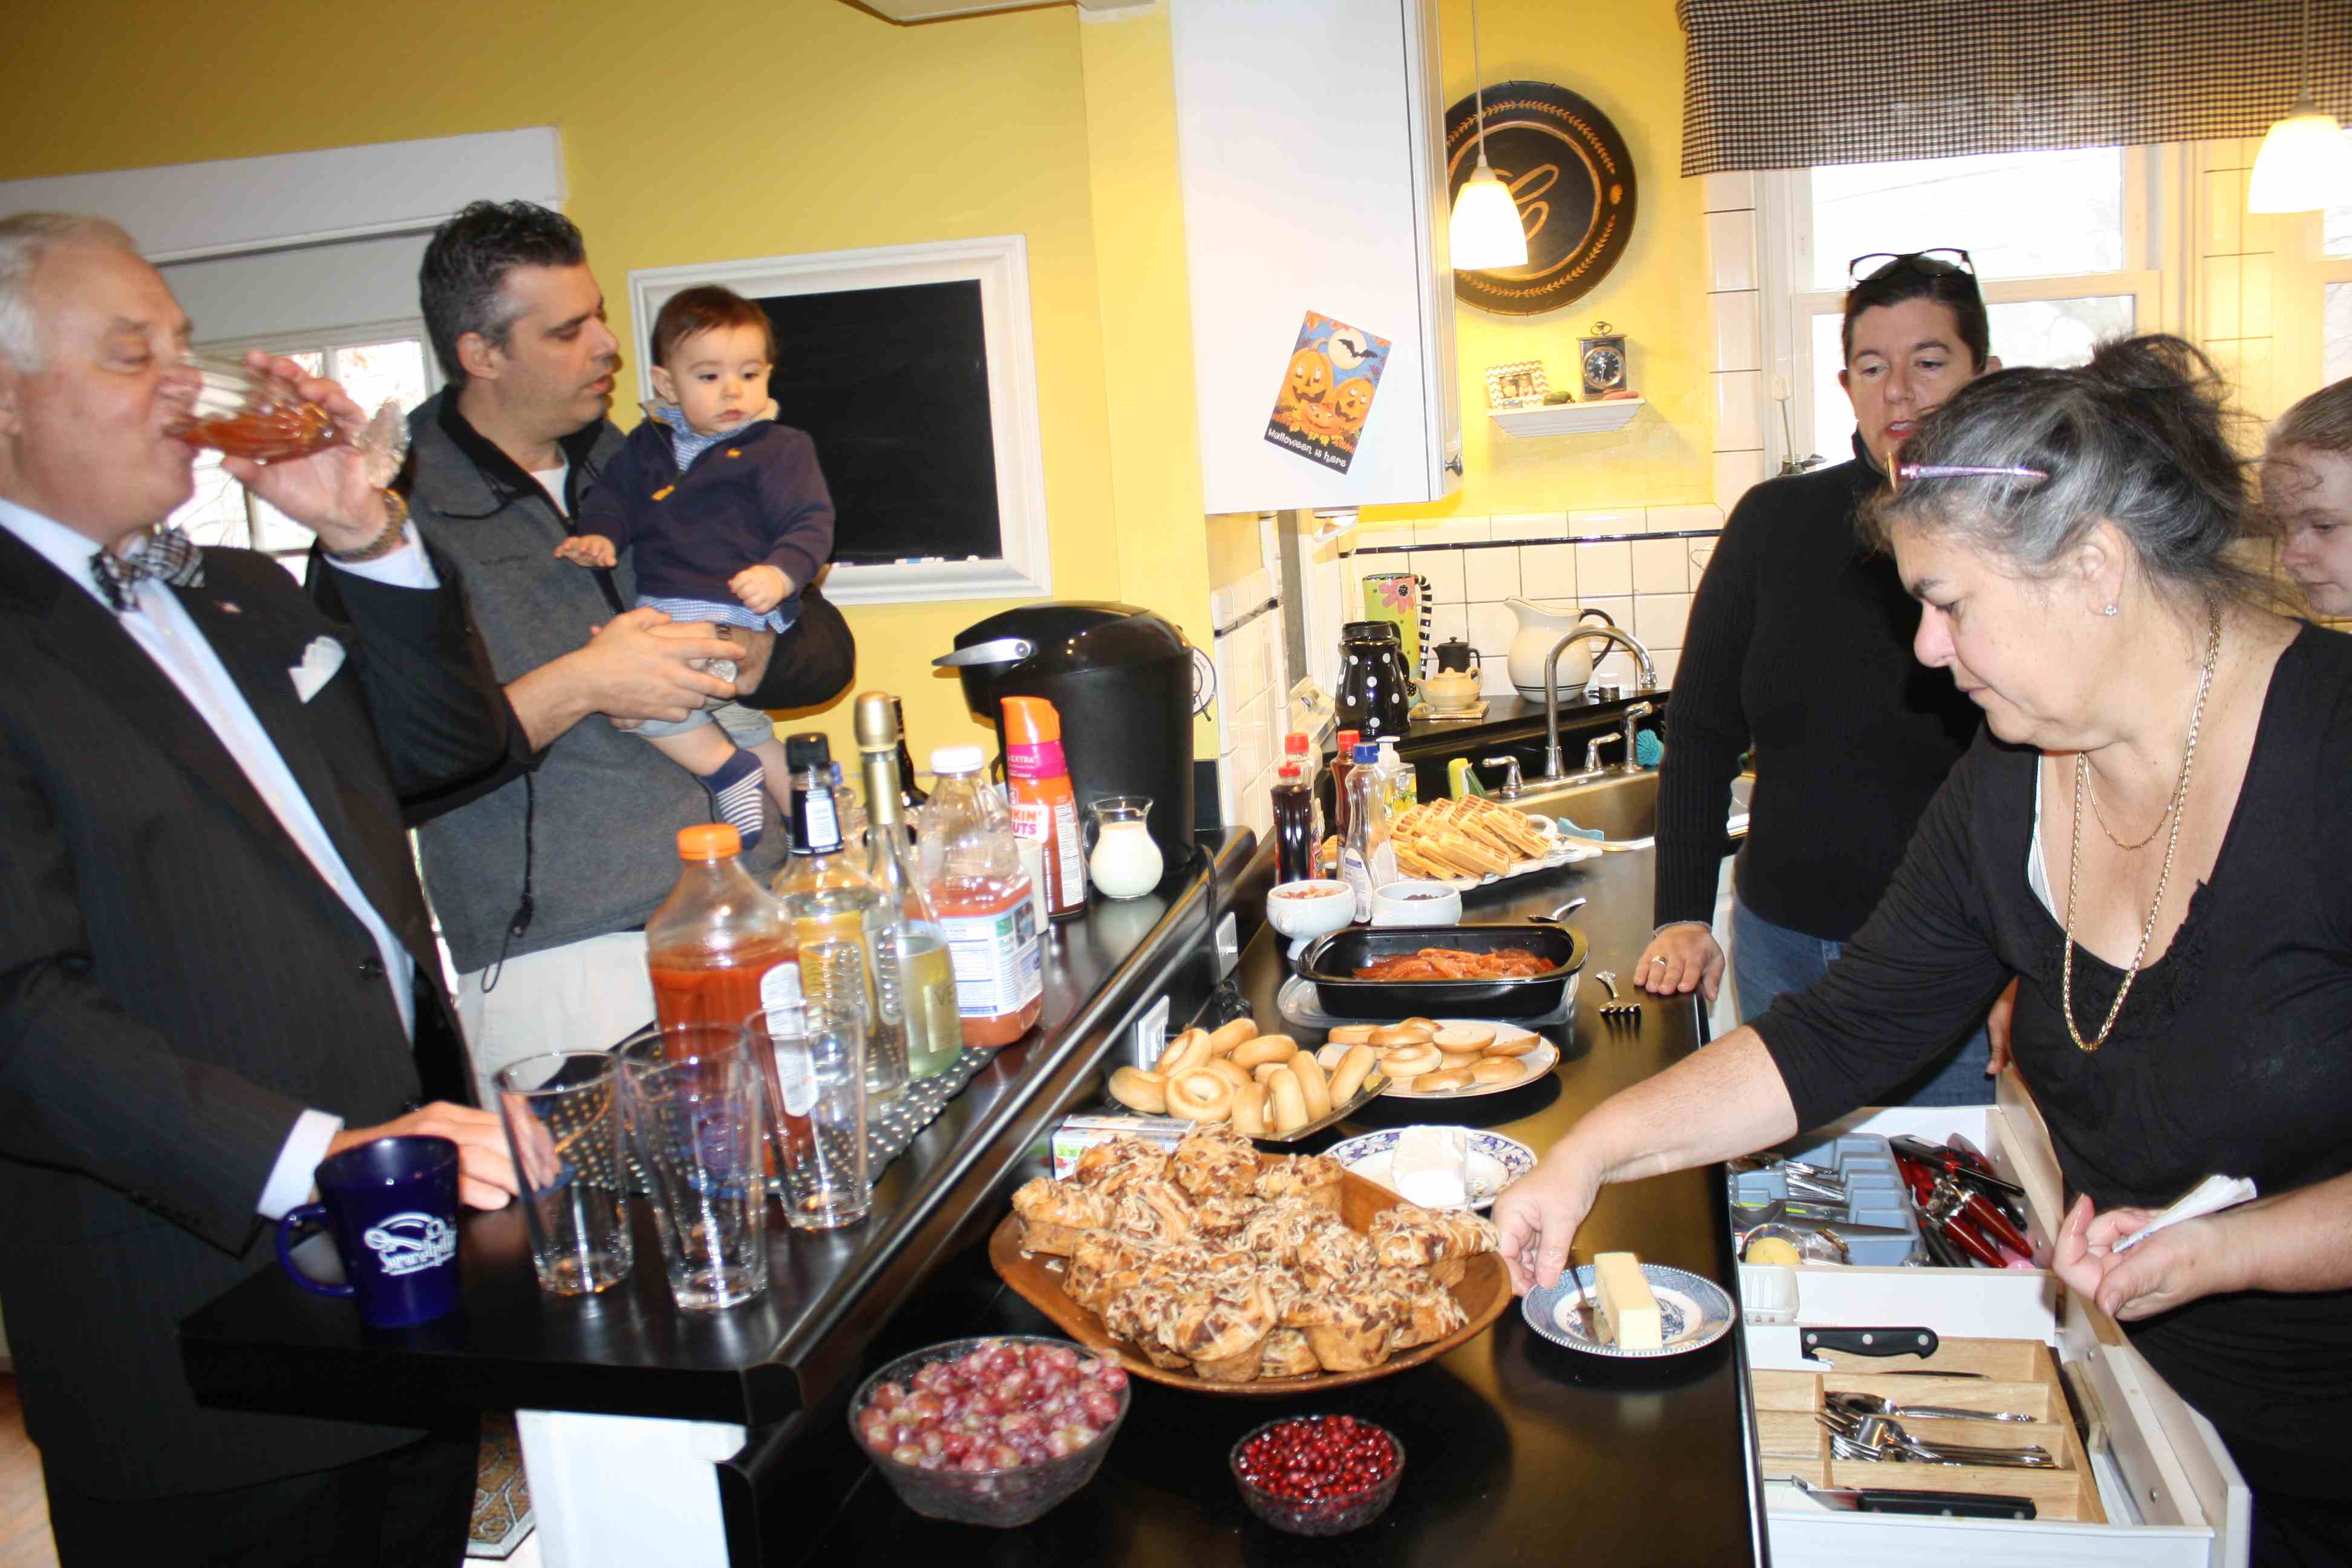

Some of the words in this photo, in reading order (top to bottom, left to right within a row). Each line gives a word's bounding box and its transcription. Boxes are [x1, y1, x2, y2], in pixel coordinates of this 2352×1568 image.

[1315, 449, 1322, 457] is
[1324, 451, 1347, 467] here
[1011, 809, 1042, 823] KIN'
[1012, 823, 1036, 835] UTS
